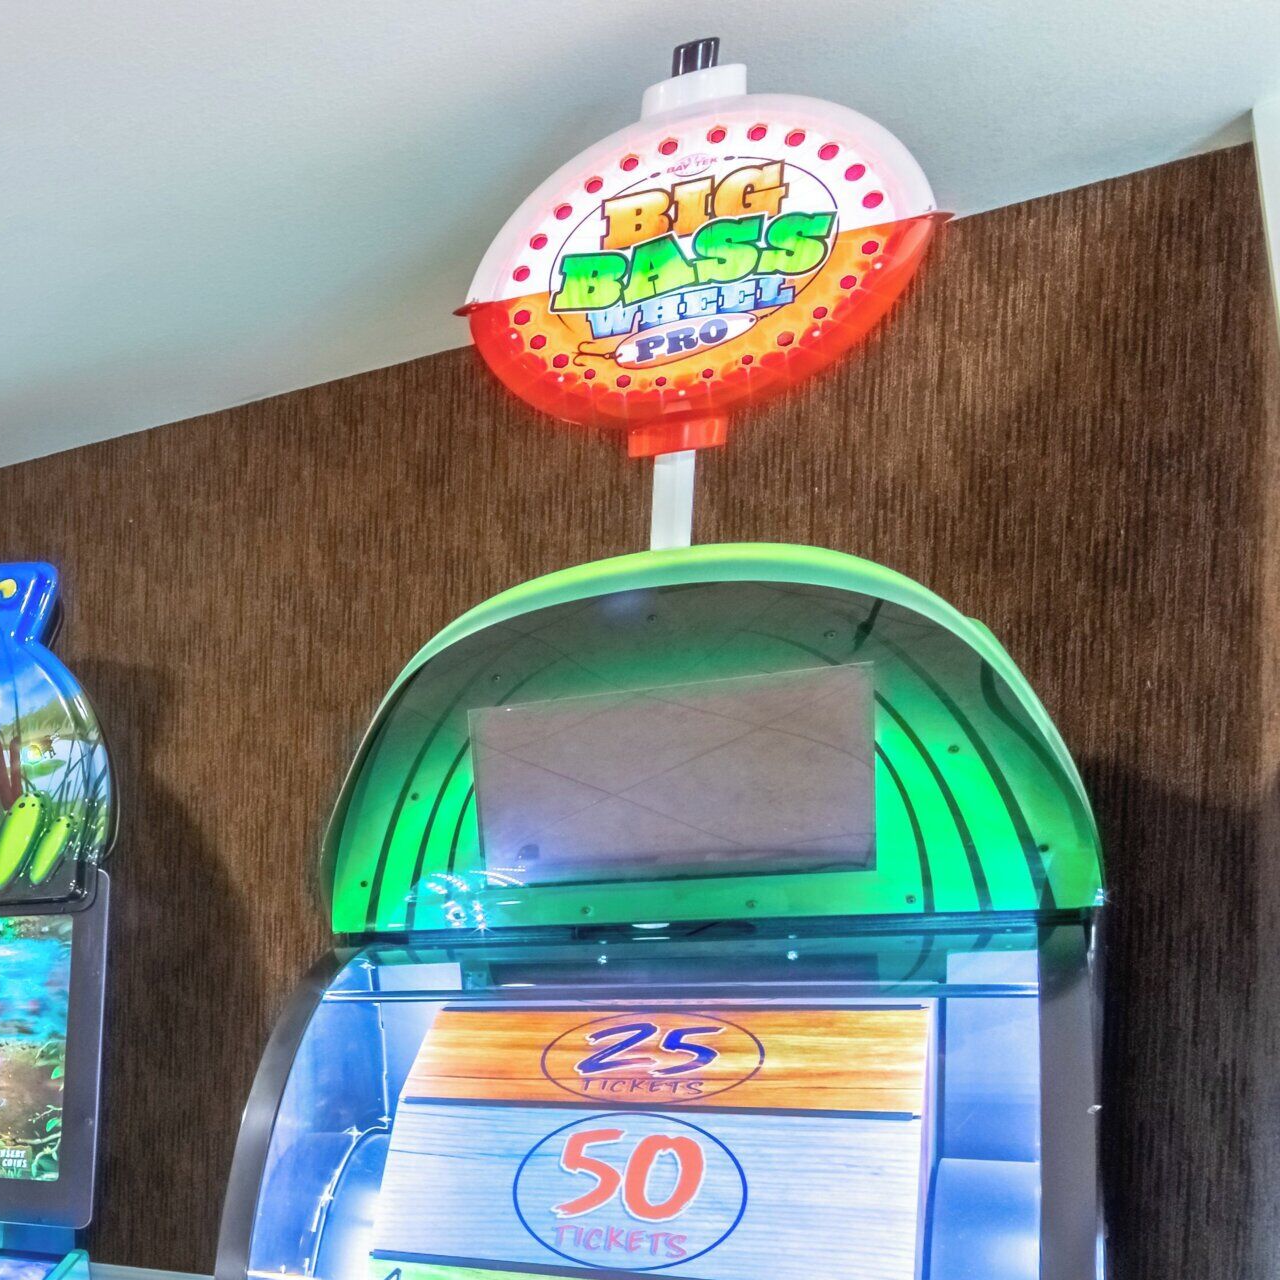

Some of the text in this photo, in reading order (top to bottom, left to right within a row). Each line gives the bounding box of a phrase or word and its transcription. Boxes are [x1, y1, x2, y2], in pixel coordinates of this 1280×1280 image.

[600, 159, 789, 251] BIG
[550, 212, 838, 312] BASS
[586, 277, 795, 340] WHEEL
[635, 319, 728, 364] PRO
[574, 1021, 726, 1077] 25
[581, 1077, 704, 1096] TICKETS
[551, 1128, 706, 1222] 50
[553, 1224, 688, 1259] TICKETS
